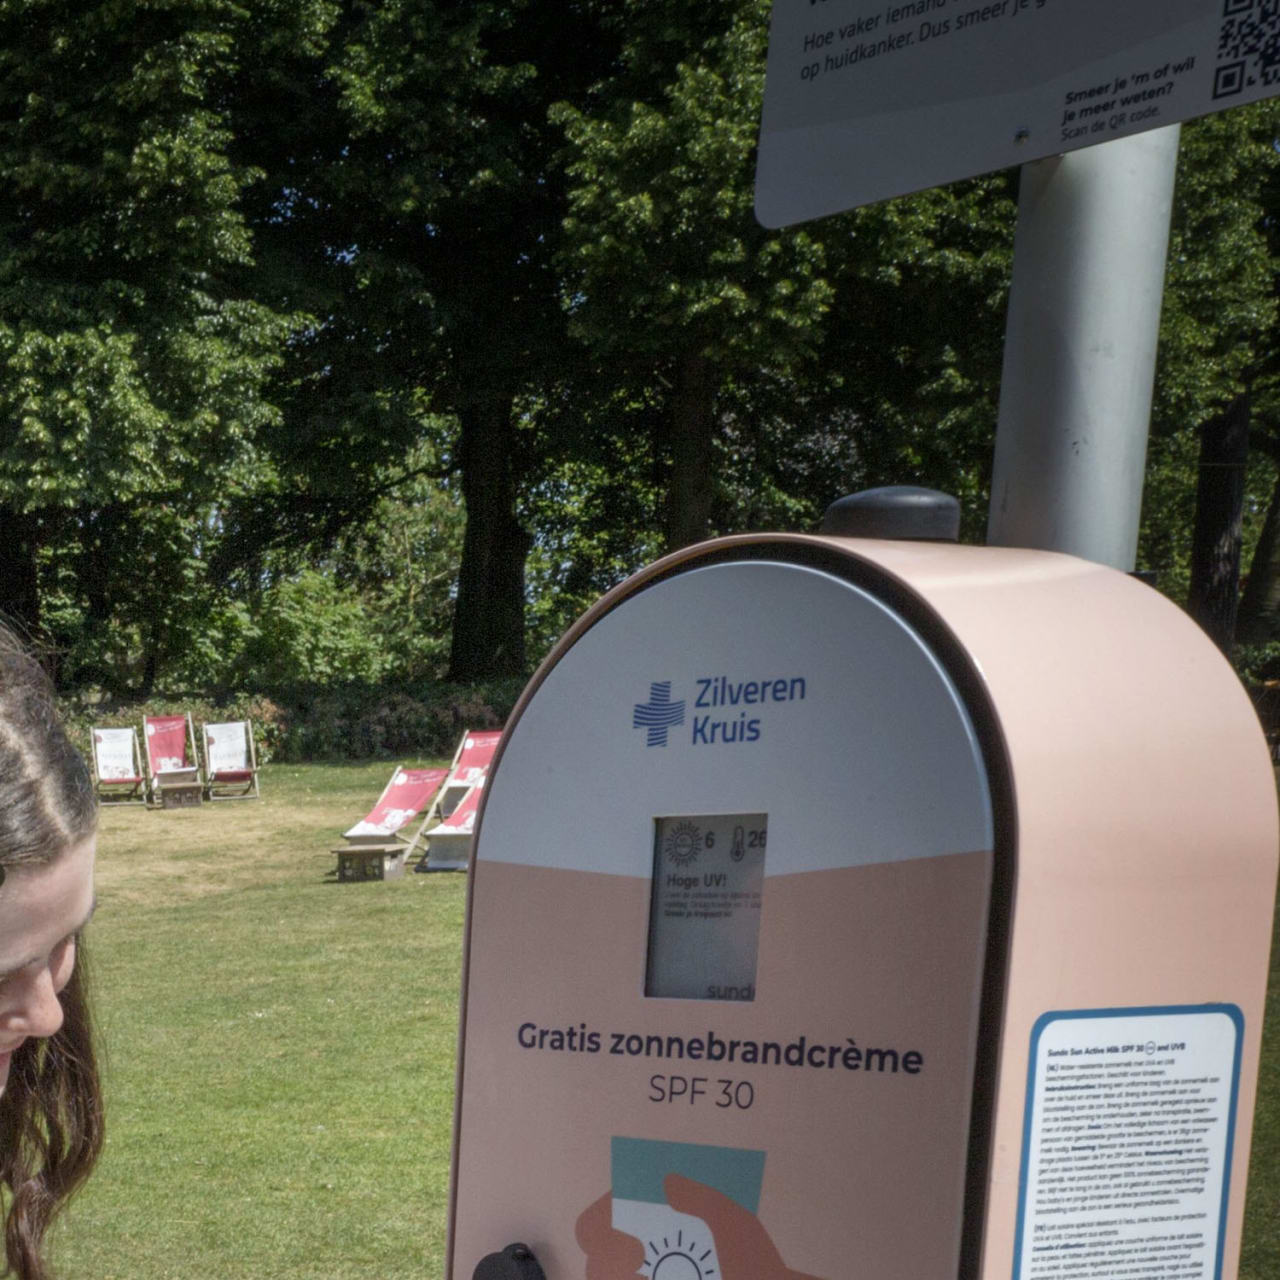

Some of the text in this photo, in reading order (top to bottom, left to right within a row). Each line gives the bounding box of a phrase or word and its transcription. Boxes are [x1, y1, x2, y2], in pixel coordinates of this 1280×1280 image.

[800, 62, 821, 82] op
[824, 32, 915, 72] huidkanker.
[919, 19, 951, 42] Dus
[955, 0, 1008, 31] smeer
[803, 31, 835, 52] Hoe
[839, 14, 882, 40] vaker
[1065, 82, 1112, 105] Smeer
[1112, 77, 1127, 95] je
[1153, 63, 1171, 79] of
[1172, 56, 1197, 74] wil
[1060, 80, 1174, 127] je meer weten?
[1060, 126, 1089, 142] Scan
[1091, 121, 1107, 132] de
[1109, 112, 1127, 130] QR
[694, 676, 807, 708] Zilveren
[692, 712, 762, 746] Kruis
[704, 831, 715, 849] 6
[665, 873, 700, 890] Hoge
[707, 983, 755, 1001] sund
[517, 1022, 924, 1075] Gratis zonnebrandcrème
[648, 1074, 755, 1111] SPF 30
